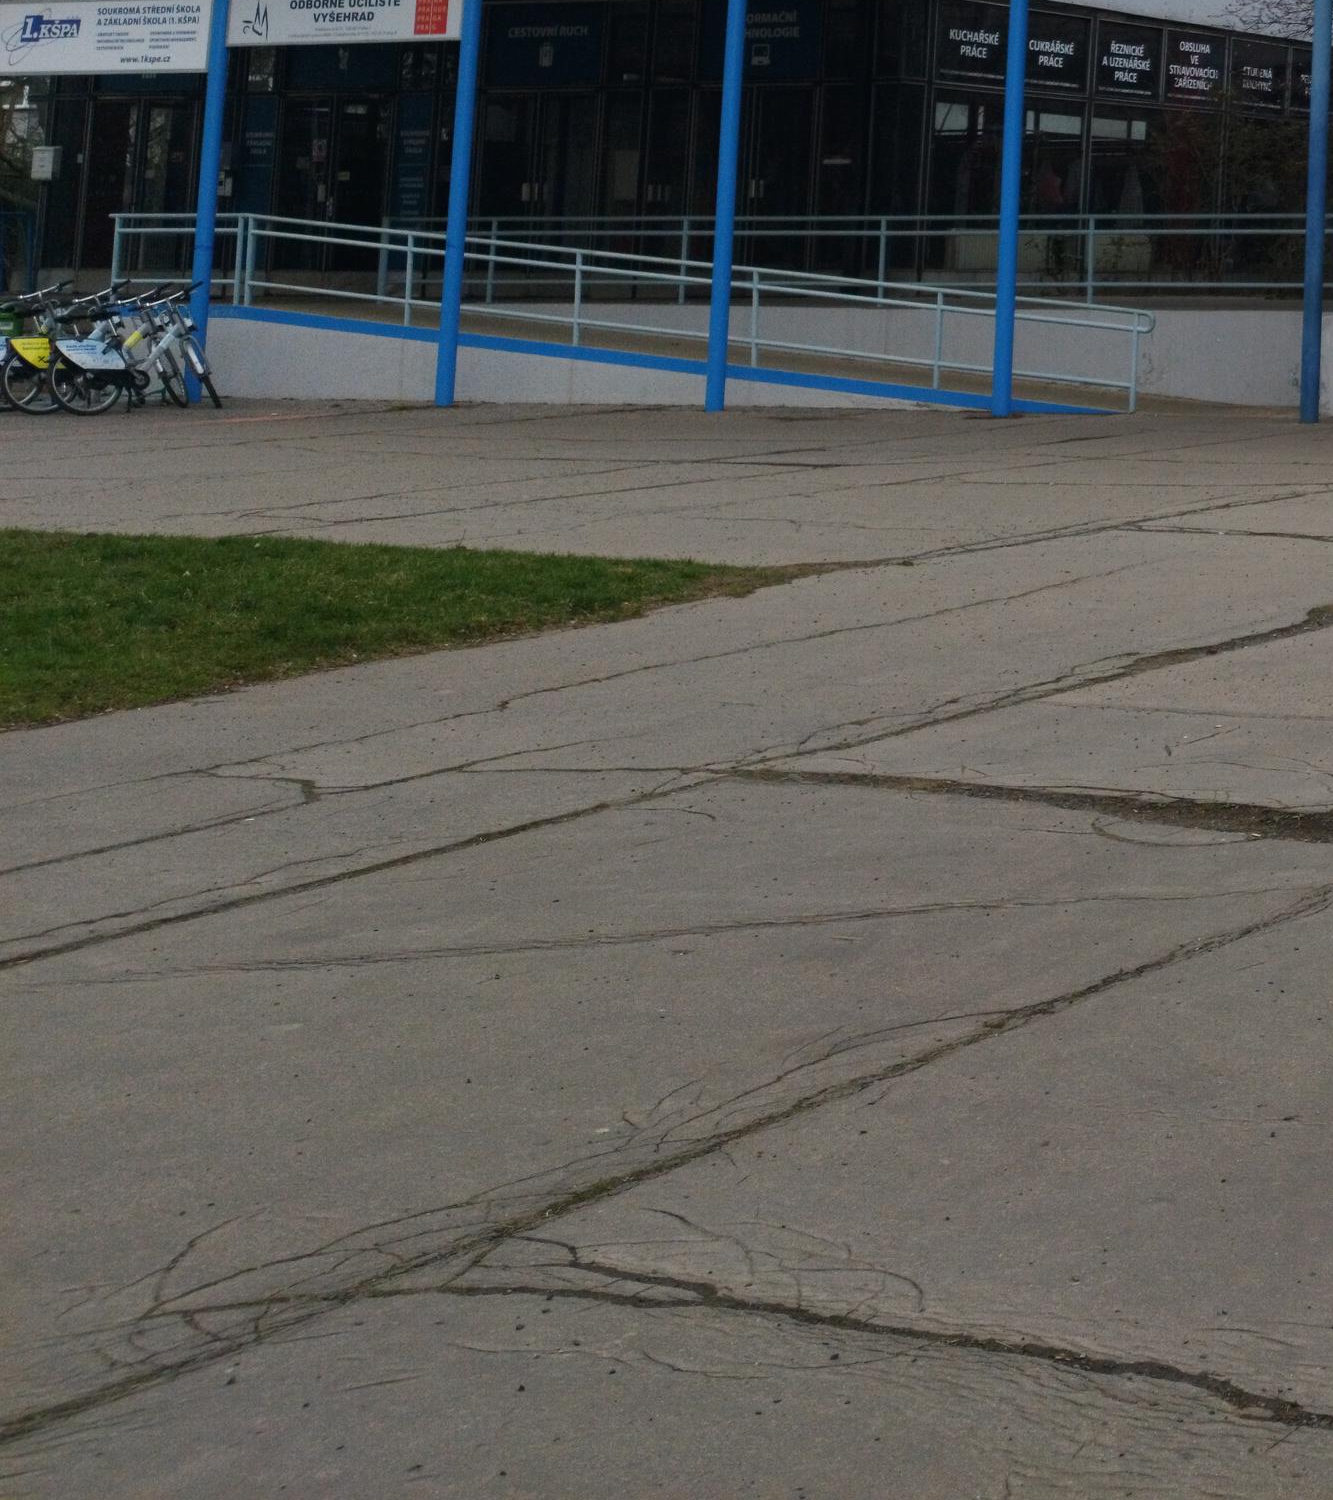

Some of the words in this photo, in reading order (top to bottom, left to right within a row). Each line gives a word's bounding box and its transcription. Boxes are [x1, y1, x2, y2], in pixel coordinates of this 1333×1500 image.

[97, 6, 141, 16] SOUKROMÁ
[142, 4, 175, 14] STŘEDNÍ
[175, 4, 201, 14] ŠKOLA
[313, 10, 375, 23] VYŠEHRAD
[96, 18, 102, 26] A
[103, 16, 141, 26] ZÁKLADNÍ
[142, 15, 167, 25] ŠKOLA
[949, 28, 1000, 46] KUCHAŘSKÉ
[960, 44, 988, 59] PRÁCE
[1028, 39, 1075, 56] CUKRÁŘSKÉ
[1110, 40, 1145, 57] ŘEZNICKÉ
[1179, 40, 1211, 54] OBSLUHA
[1038, 54, 1064, 69] PRÁCE
[1101, 56, 1108, 66] A
[1109, 56, 1151, 71] UZENÁŘSKÉ
[1190, 54, 1200, 65] VE
[1114, 70, 1138, 84] PRÁCE
